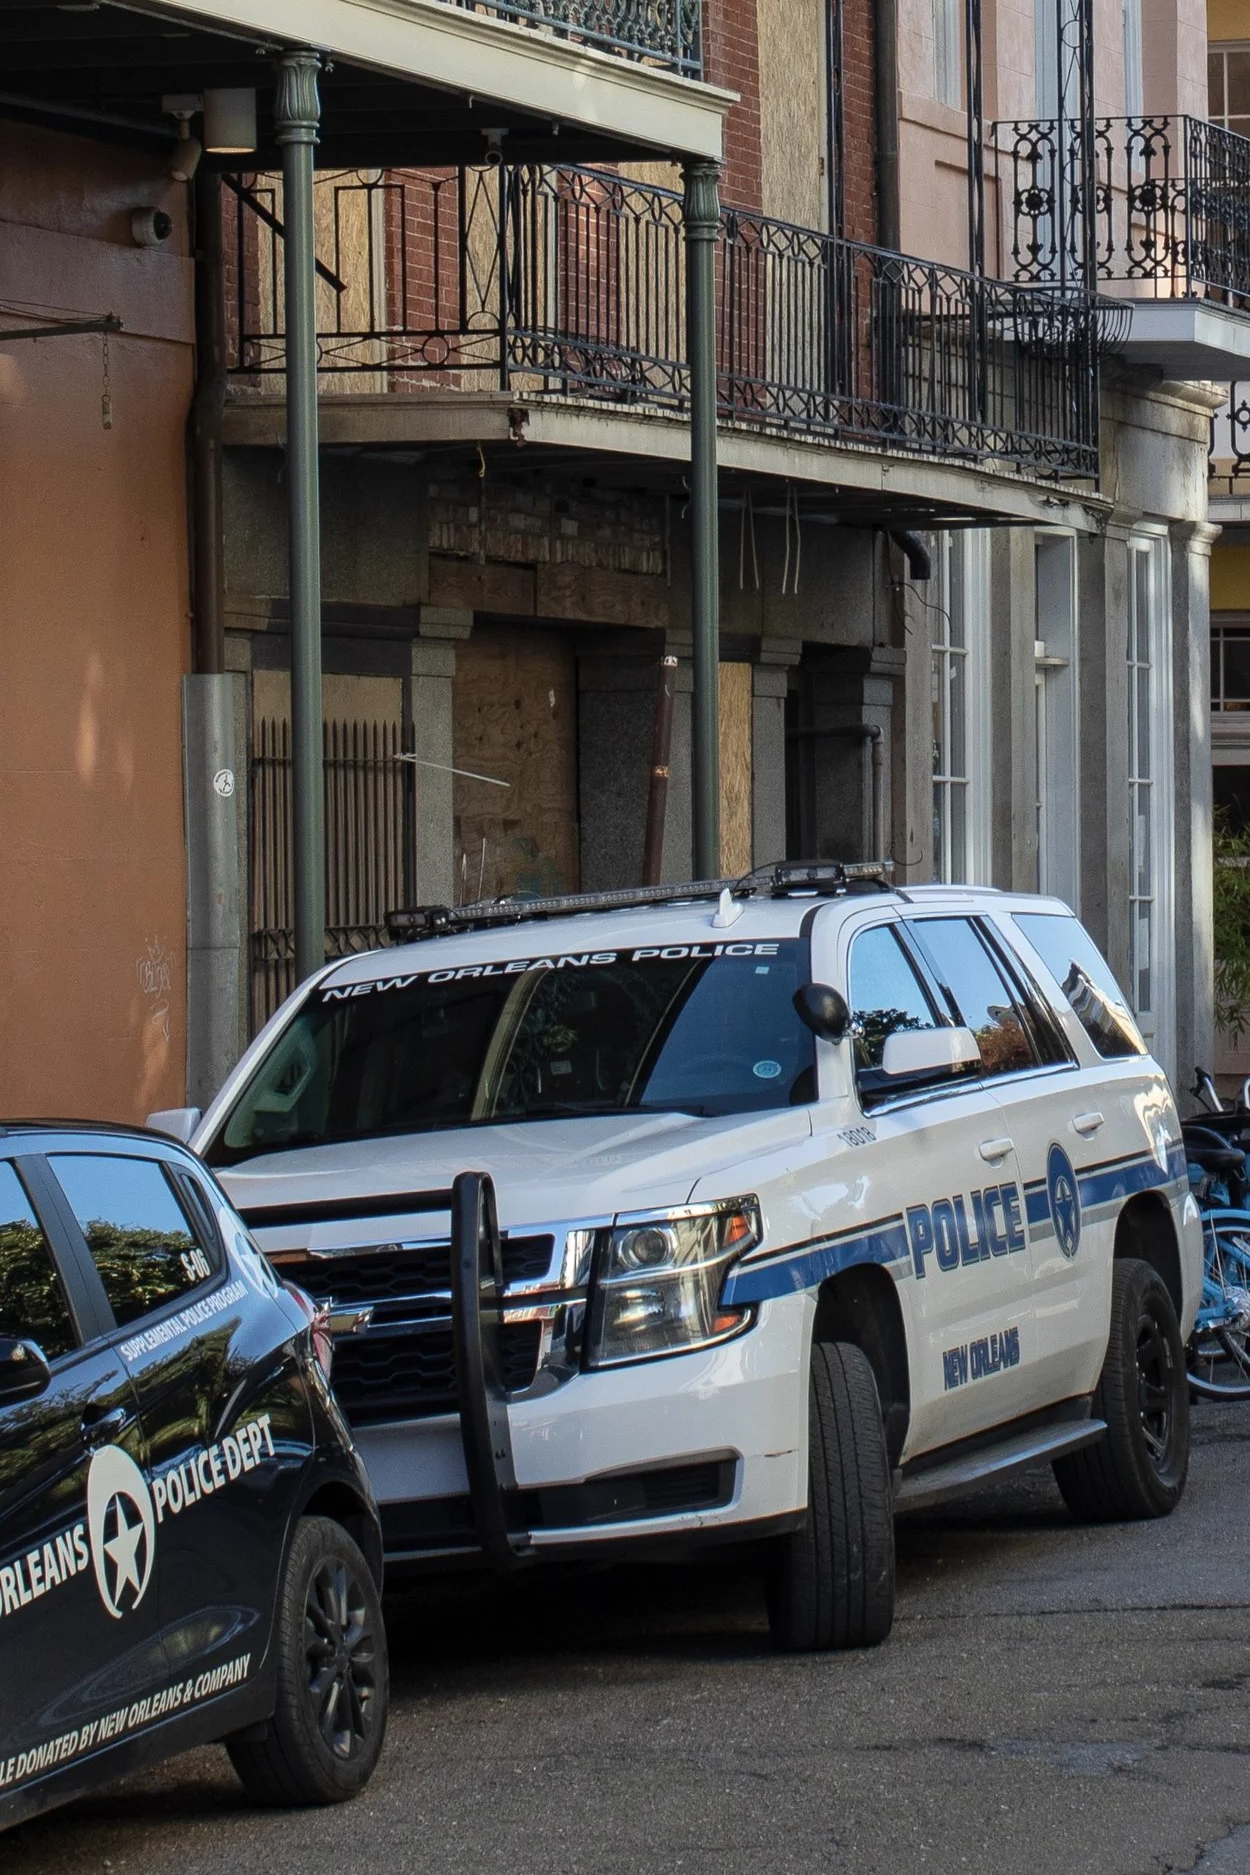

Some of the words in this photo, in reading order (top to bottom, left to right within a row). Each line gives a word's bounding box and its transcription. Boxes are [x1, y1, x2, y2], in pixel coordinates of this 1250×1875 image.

[322, 974, 417, 1002] NEW
[427, 951, 617, 985] ORLEANS
[631, 943, 781, 962] POLICE
[836, 1126, 878, 1148] 18018
[180, 1247, 211, 1282] S-06
[906, 1181, 1026, 1280] POLICE
[120, 1316, 188, 1362] SUPPLEMENTAL
[181, 1297, 214, 1329] POLICE
[206, 1280, 249, 1317] PROGRAM
[943, 1343, 968, 1391] NEW
[969, 1326, 1020, 1380] ORLEANS
[0, 1524, 90, 1618] RLEANS
[152, 1443, 226, 1524] POLICE
[221, 1413, 275, 1481] DEPT
[17, 1730, 79, 1779] DONATED
[78, 1721, 99, 1752] BY
[97, 1707, 129, 1743] NEW
[127, 1682, 184, 1728] ORLEANS
[182, 1678, 194, 1704] &
[193, 1653, 251, 1699] COMPANY
